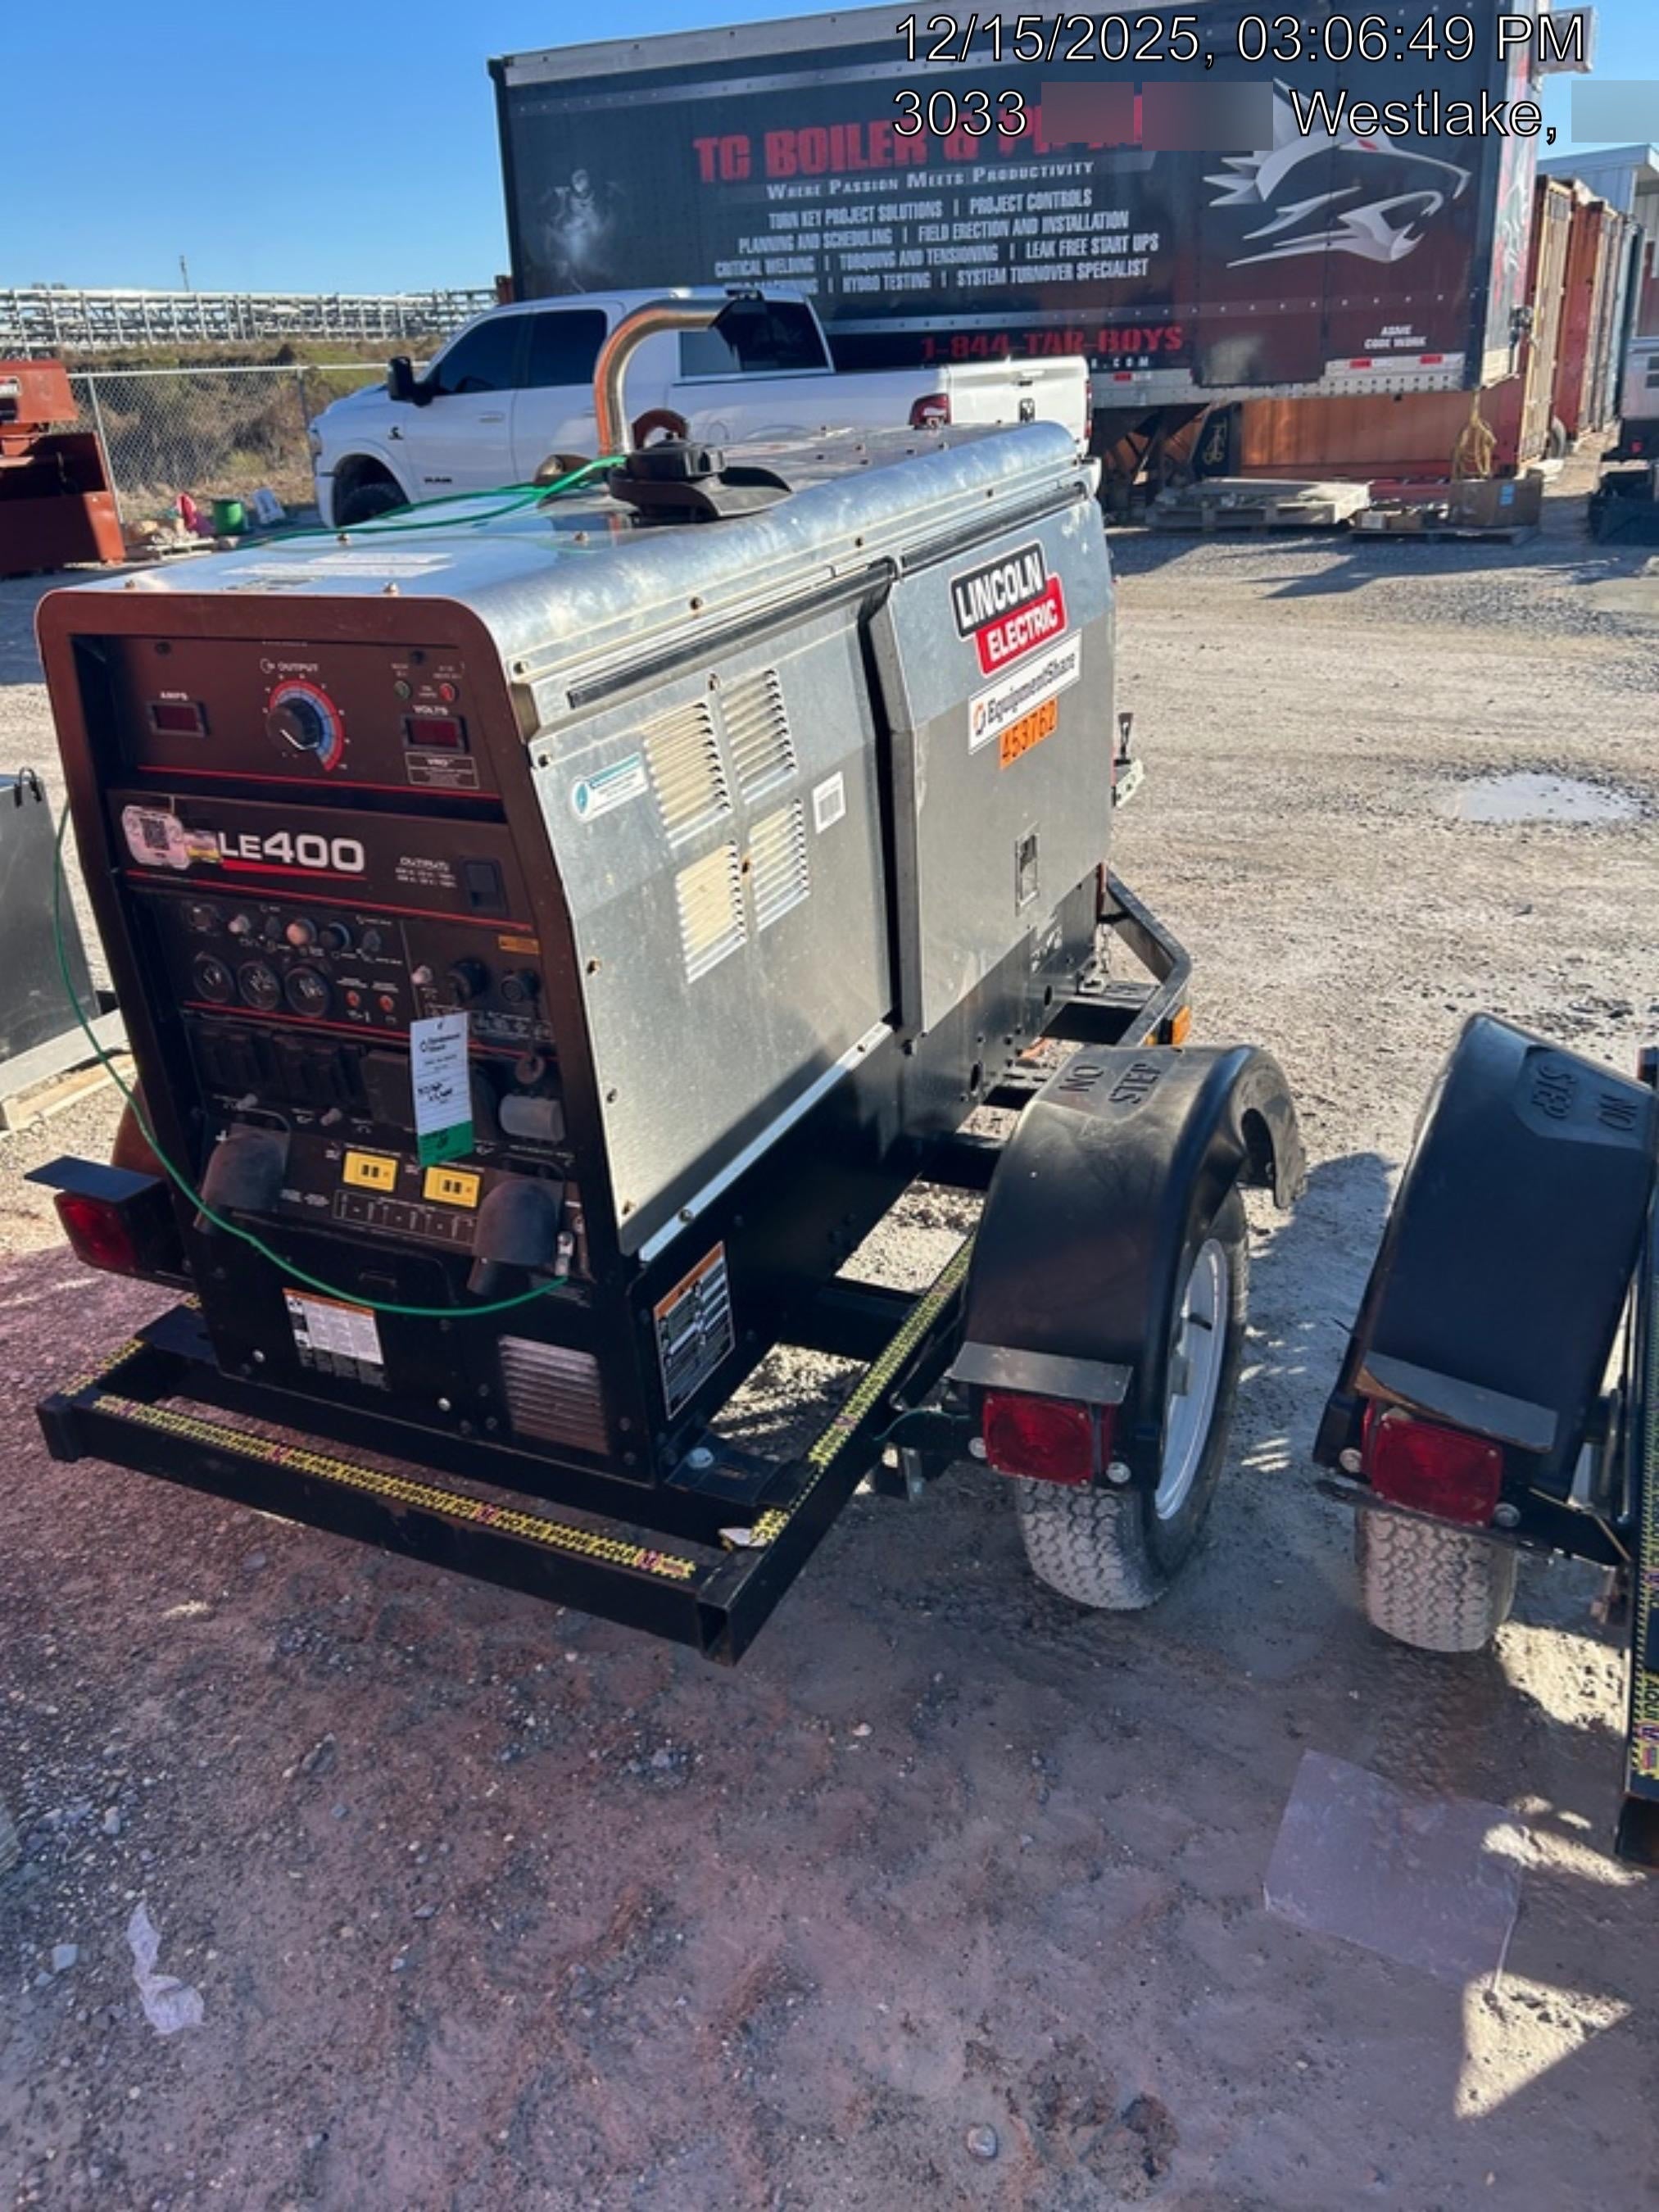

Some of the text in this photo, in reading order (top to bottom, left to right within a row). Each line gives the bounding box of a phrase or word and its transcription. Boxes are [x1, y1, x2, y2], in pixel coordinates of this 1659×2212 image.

[693, 133, 751, 183] TC
[764, 115, 927, 179] BOILER
[800, 209, 821, 228] KEY
[824, 205, 876, 226] PROJECT
[877, 201, 943, 223] SOLUTIONS
[969, 188, 1092, 215] PROJECT CONTROLS
[918, 210, 1130, 243] FIELD ERECTION AND INSTALLATION
[739, 227, 893, 255] PLANNING AND SCHEDULING
[1026, 233, 1159, 260] LEAK FREE START UPS
[714, 256, 816, 279] CRITICAL WELDING
[899, 248, 924, 267] AND
[925, 244, 999, 266] TENSIONING
[842, 274, 881, 294] HYDRO
[882, 271, 931, 291] TESTING
[957, 256, 1150, 288] SYSTEM TURNOVER SPECIALIST
[921, 326, 1182, 360] 1-844-TAR-BOYS
[955, 551, 1043, 629] LINCOLN
[986, 599, 1058, 662] ELECTRIC
[277, 661, 319, 672] OUTPUT
[412, 705, 448, 716] VOLTS
[218, 831, 365, 873] LE400
[1058, 1065, 1104, 1093] NO
[1108, 1063, 1162, 1104] STEP
[1530, 1064, 1579, 1121] STEP
